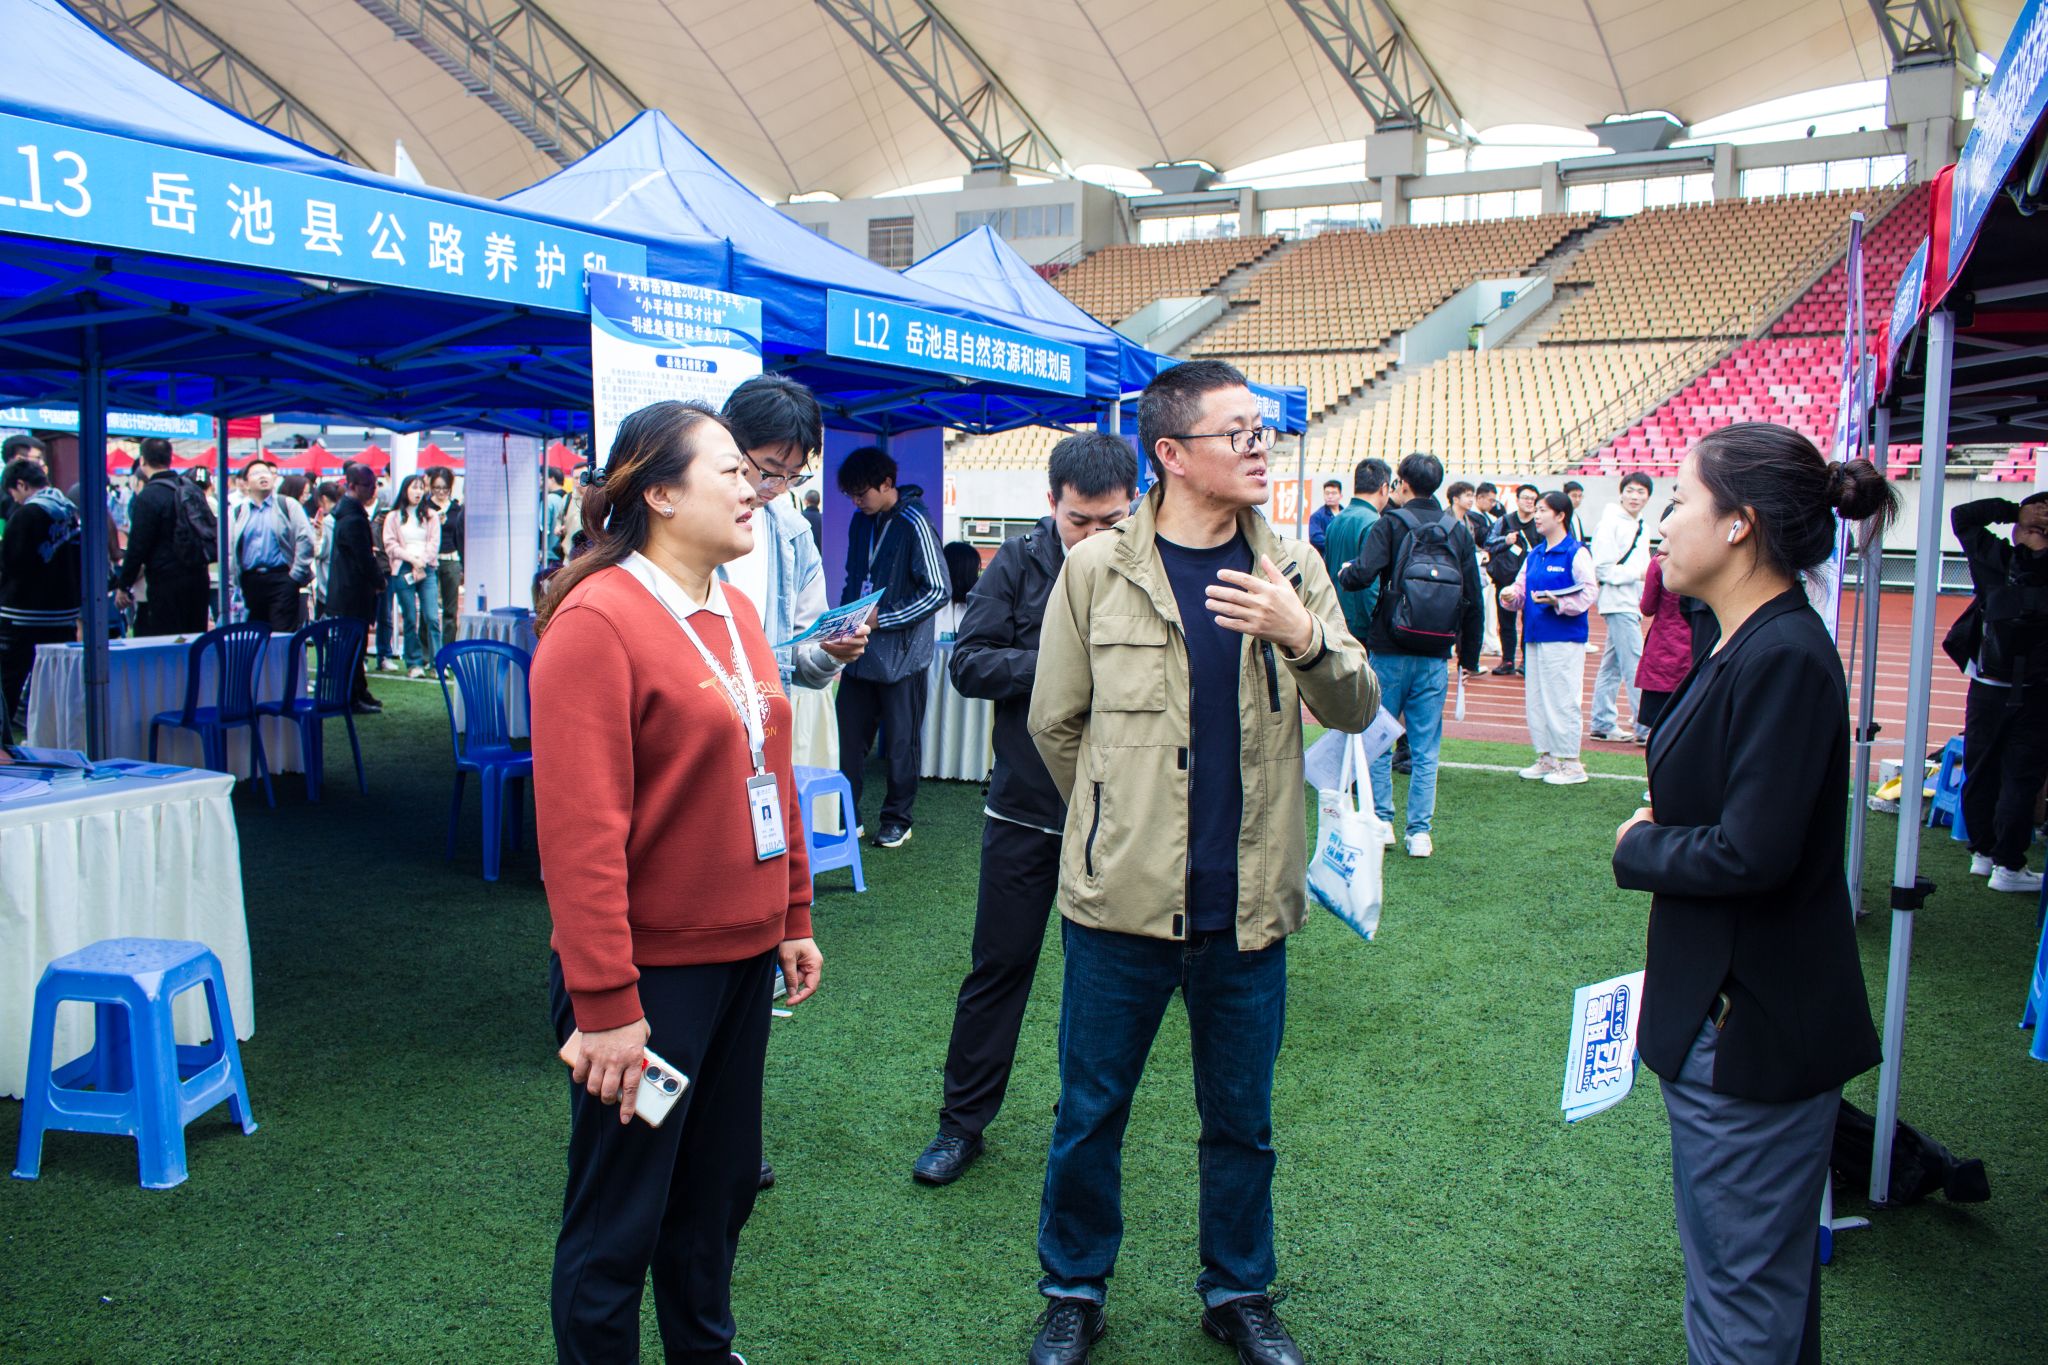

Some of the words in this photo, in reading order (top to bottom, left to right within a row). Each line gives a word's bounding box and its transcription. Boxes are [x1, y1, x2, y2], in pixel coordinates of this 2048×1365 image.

[0, 144, 92, 218] 13
[853, 307, 889, 351] L12
[905, 320, 1071, 384] 岳池县自然资源和规划局
[1614, 990, 1626, 1035] 加入我们
[1584, 994, 1622, 1089] 招聘
[1586, 1044, 1595, 1061] US
[1582, 1063, 1593, 1091] JOIN
